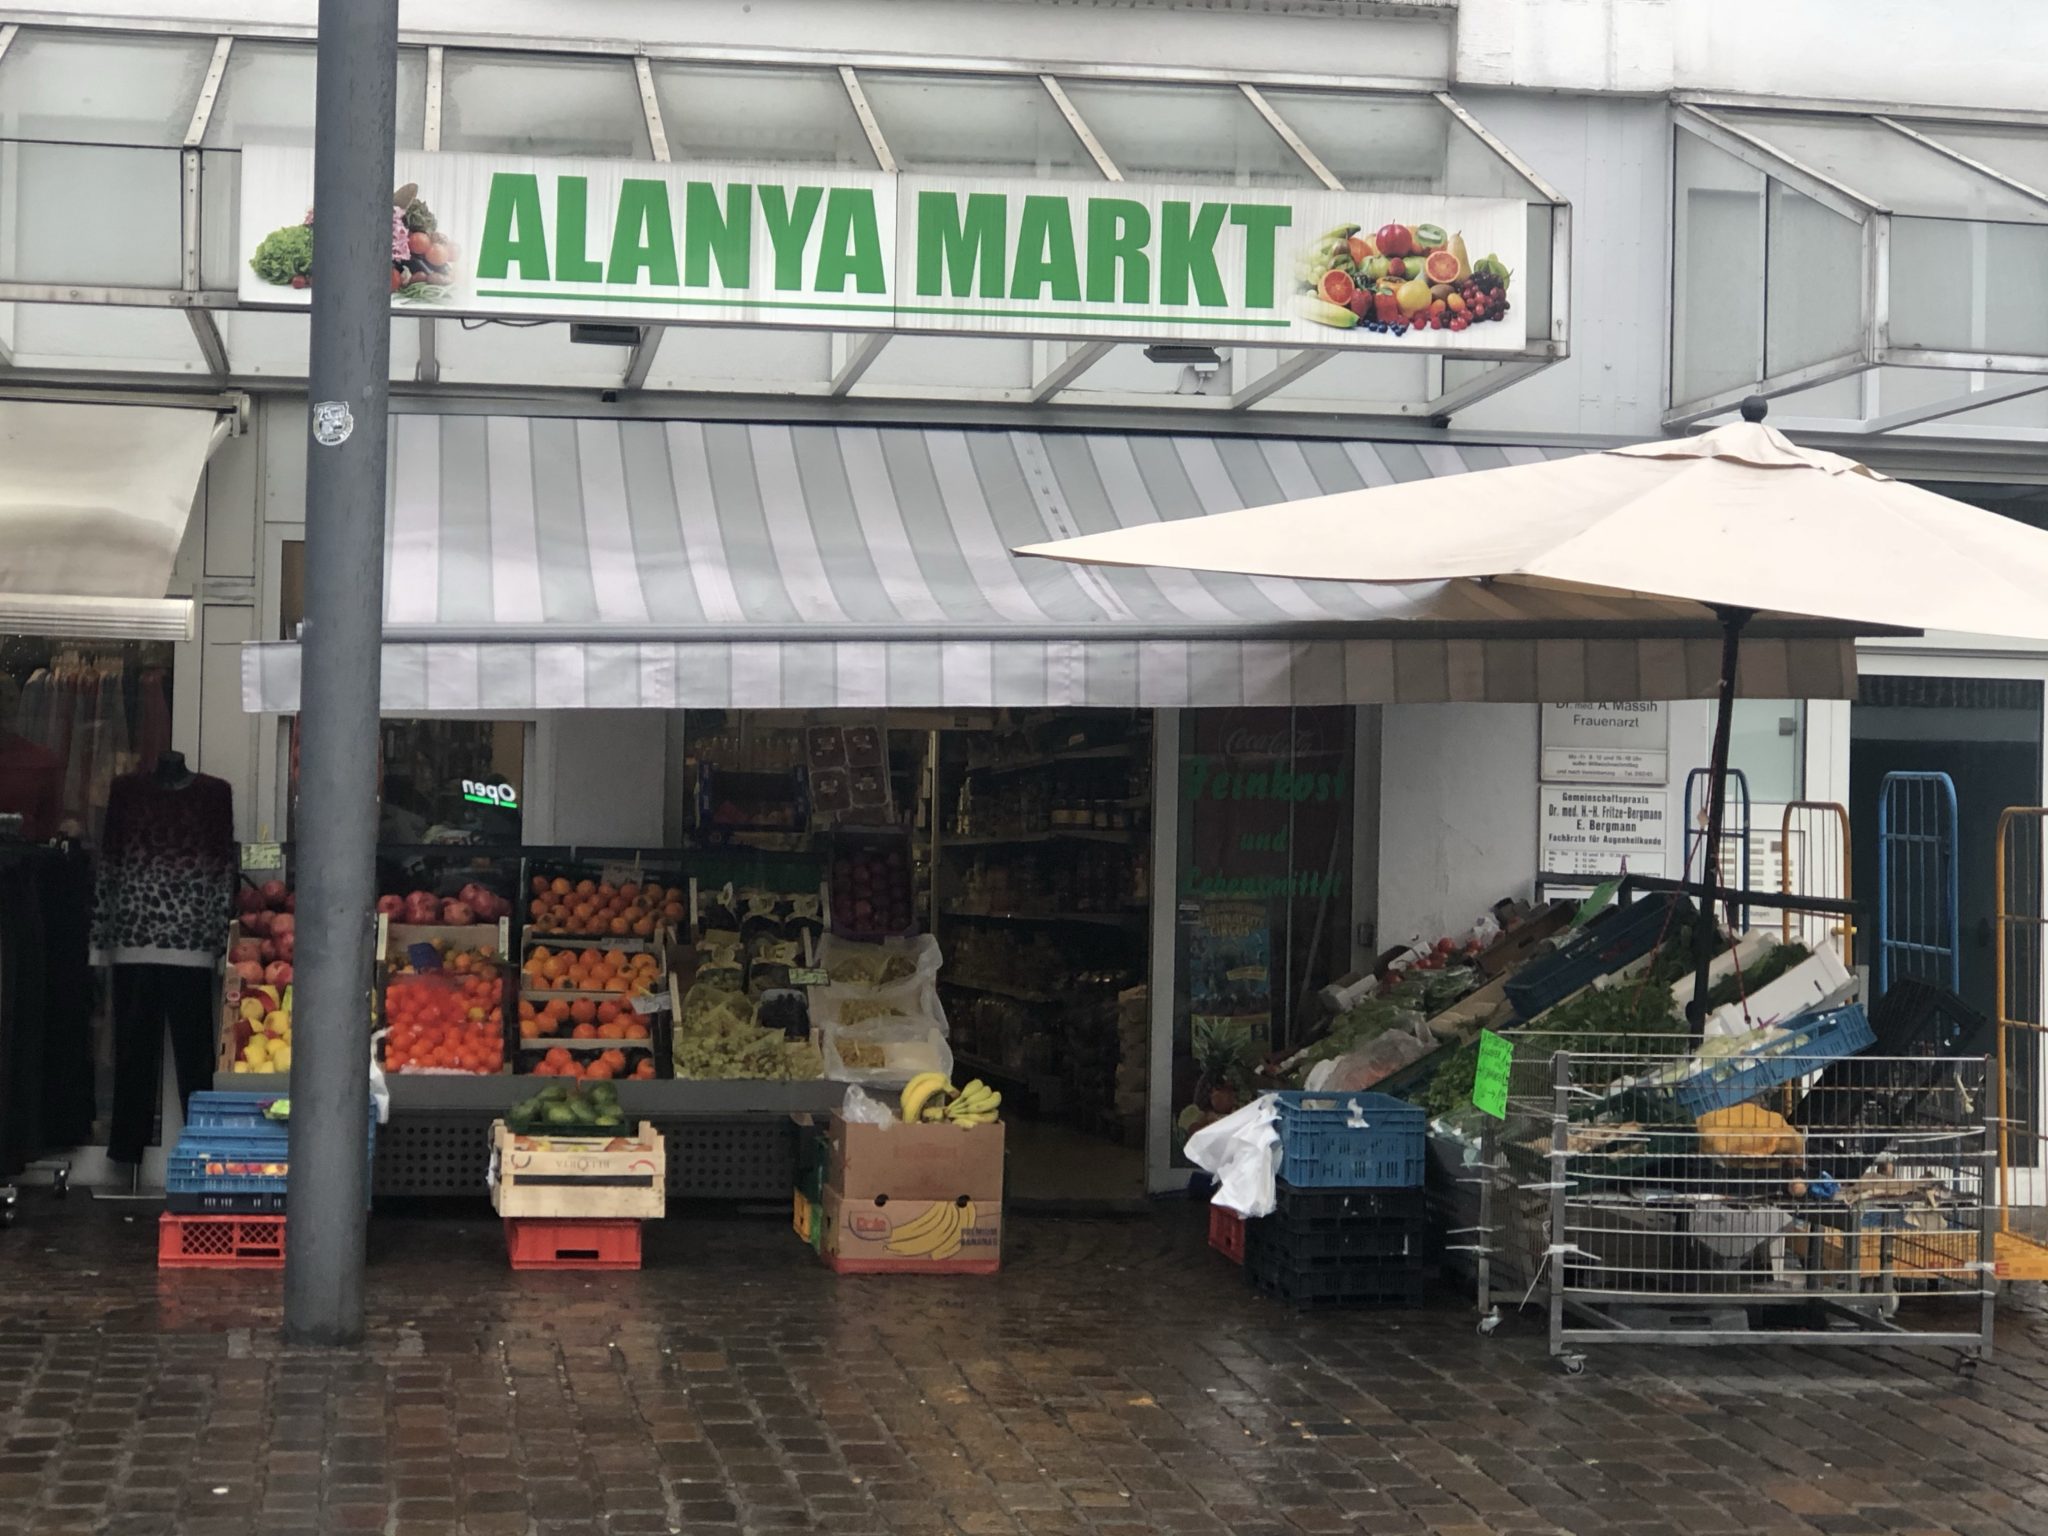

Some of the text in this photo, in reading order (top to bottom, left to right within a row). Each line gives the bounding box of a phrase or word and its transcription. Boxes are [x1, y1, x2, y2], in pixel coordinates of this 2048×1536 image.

[476, 172, 1293, 309] ALANYA MARKT
[1573, 714, 1639, 727] Frauenarzt
[1184, 754, 1346, 800] Feinkost
[1562, 792, 1649, 804] Gemeinschaftspraxis
[1548, 804, 1559, 817] Dr.
[1562, 804, 1578, 817] med.
[1602, 805, 1662, 821] Fritze-Bergmann
[1576, 819, 1637, 833] E. Bergmann
[1240, 824, 1288, 852] und
[1549, 833, 1662, 846] Fachärzte für Augenheilkunde
